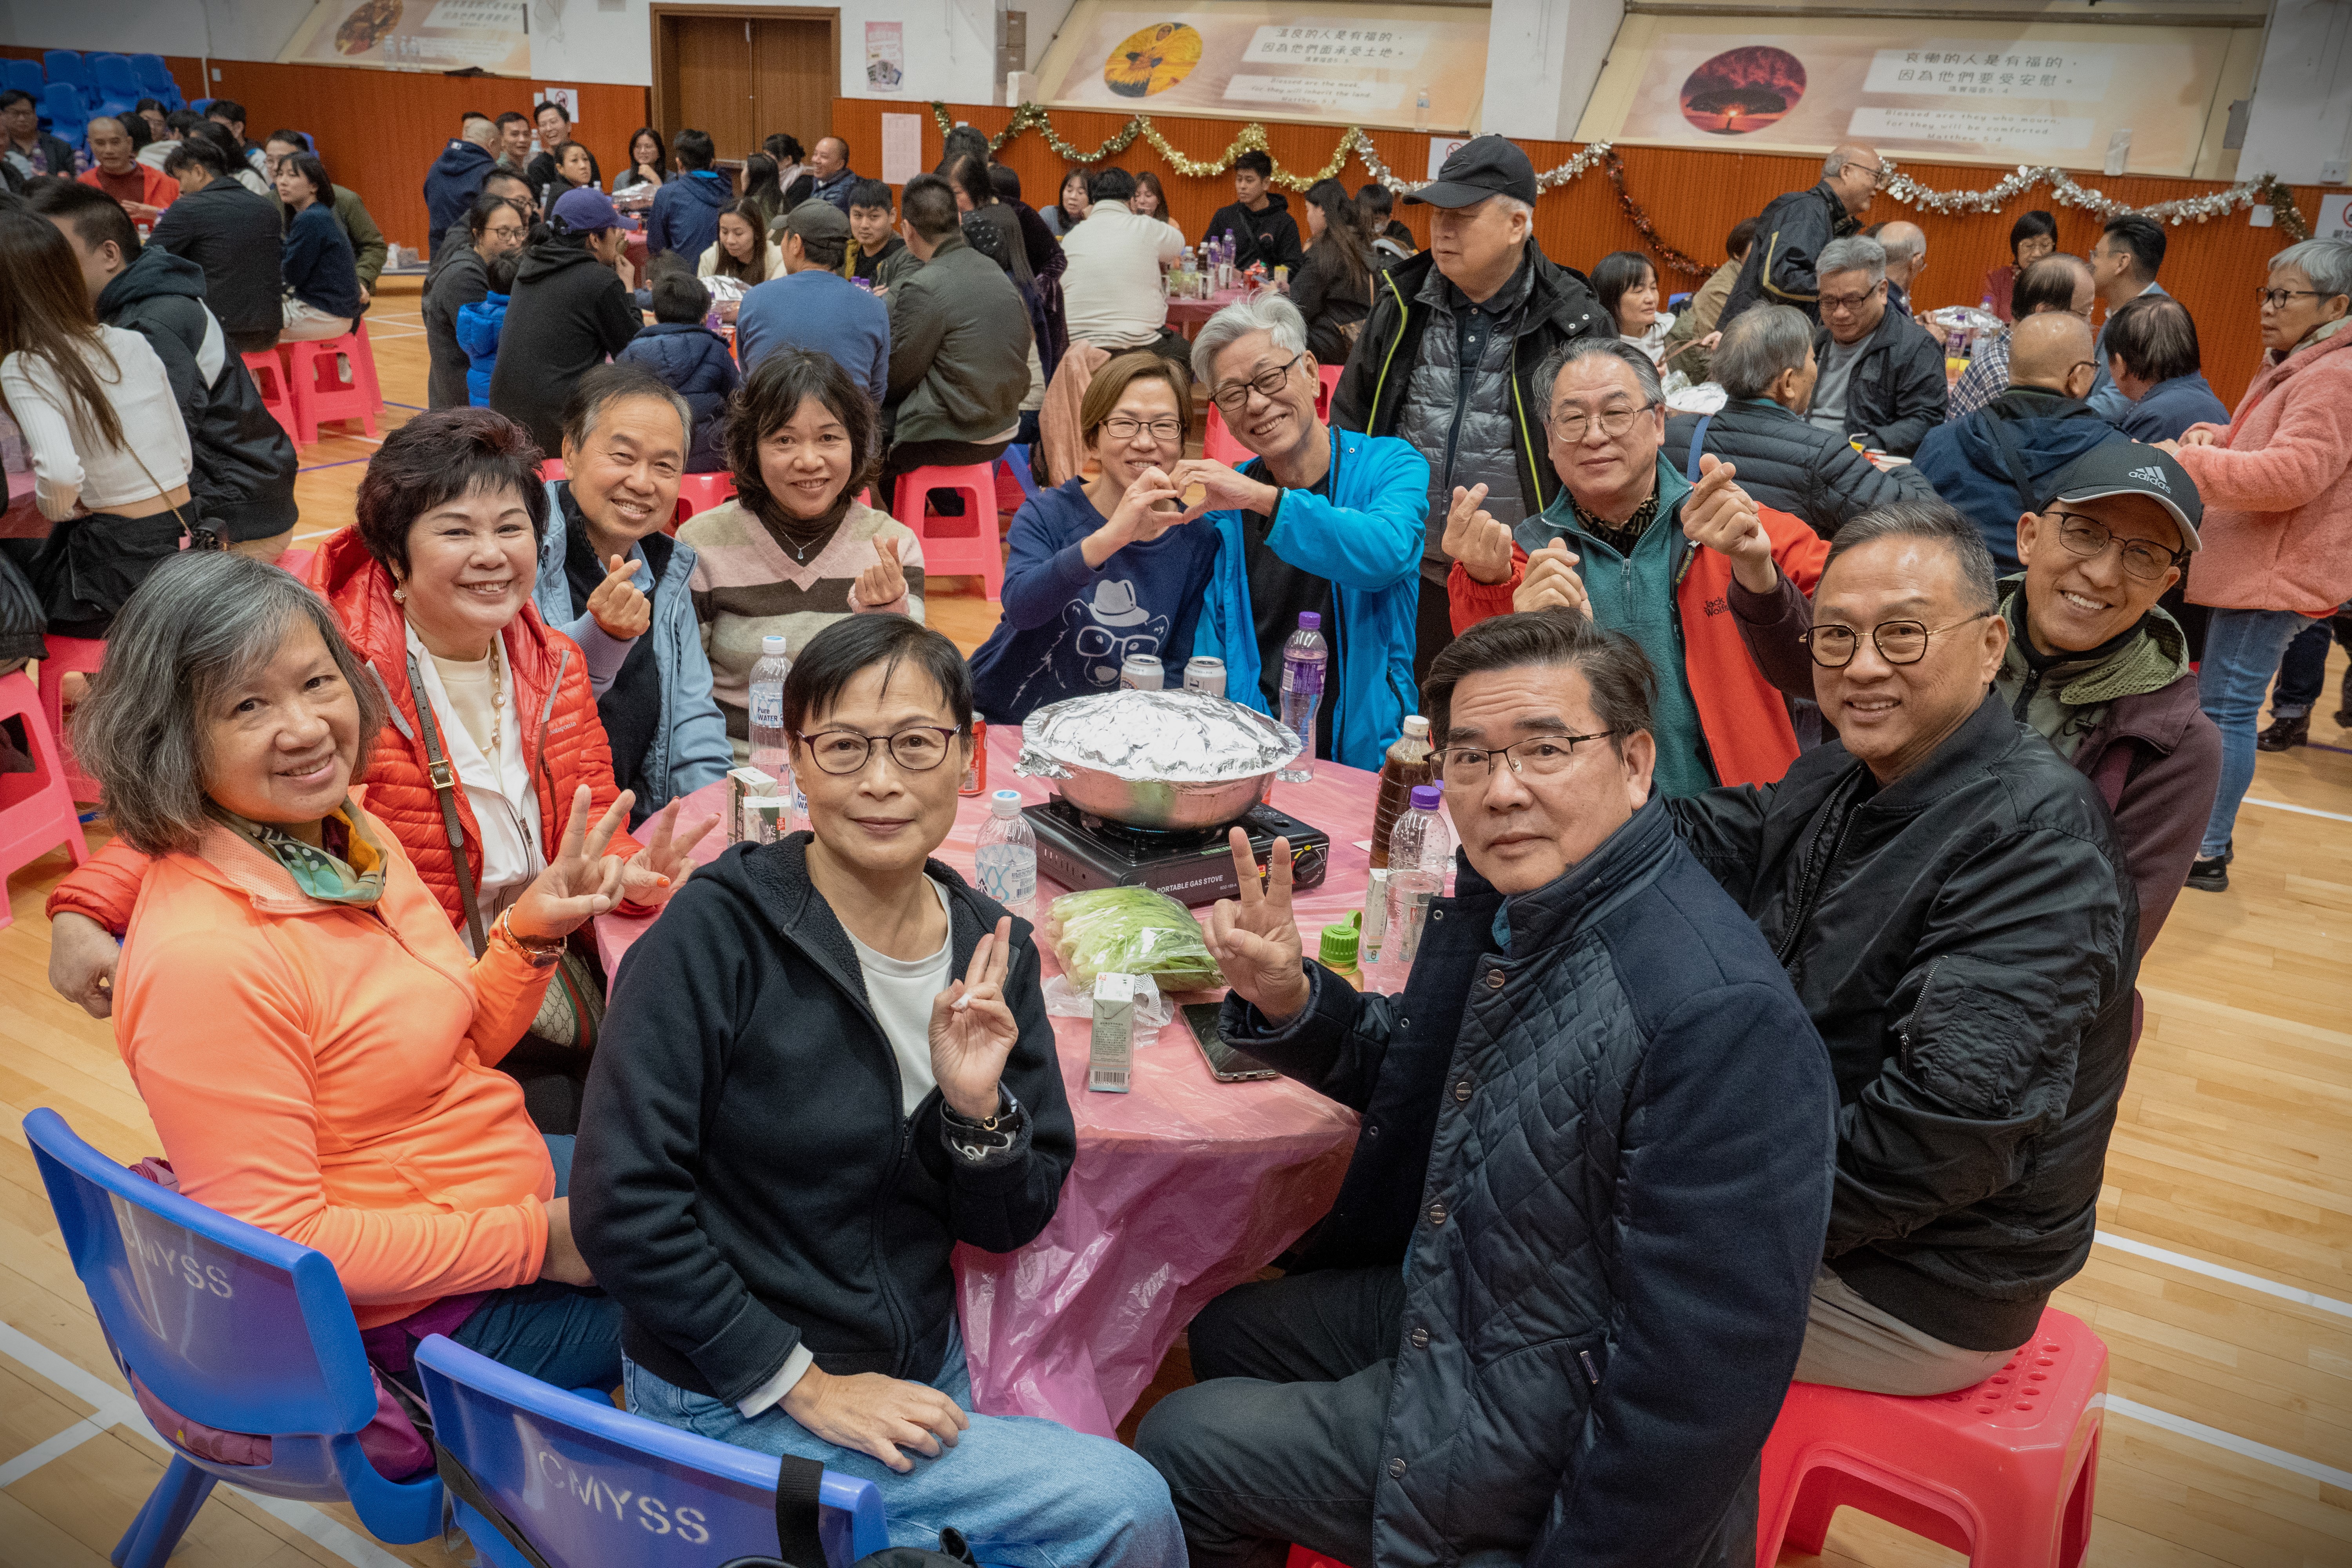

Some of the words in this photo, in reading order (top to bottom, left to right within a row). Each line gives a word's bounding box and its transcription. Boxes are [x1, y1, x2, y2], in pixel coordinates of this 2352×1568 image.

[2129, 472, 2171, 494] adidas
[1705, 596, 1725, 607] Jack
[1704, 604, 1729, 618] Wolfs
[550, 722, 576, 736] patagonia
[798, 793, 807, 801] Pur
[1157, 884, 1189, 893] PORTABLE
[1203, 875, 1223, 885] STOVE
[118, 1214, 232, 1298] CMYSS
[539, 1451, 709, 1544] CMYSS
